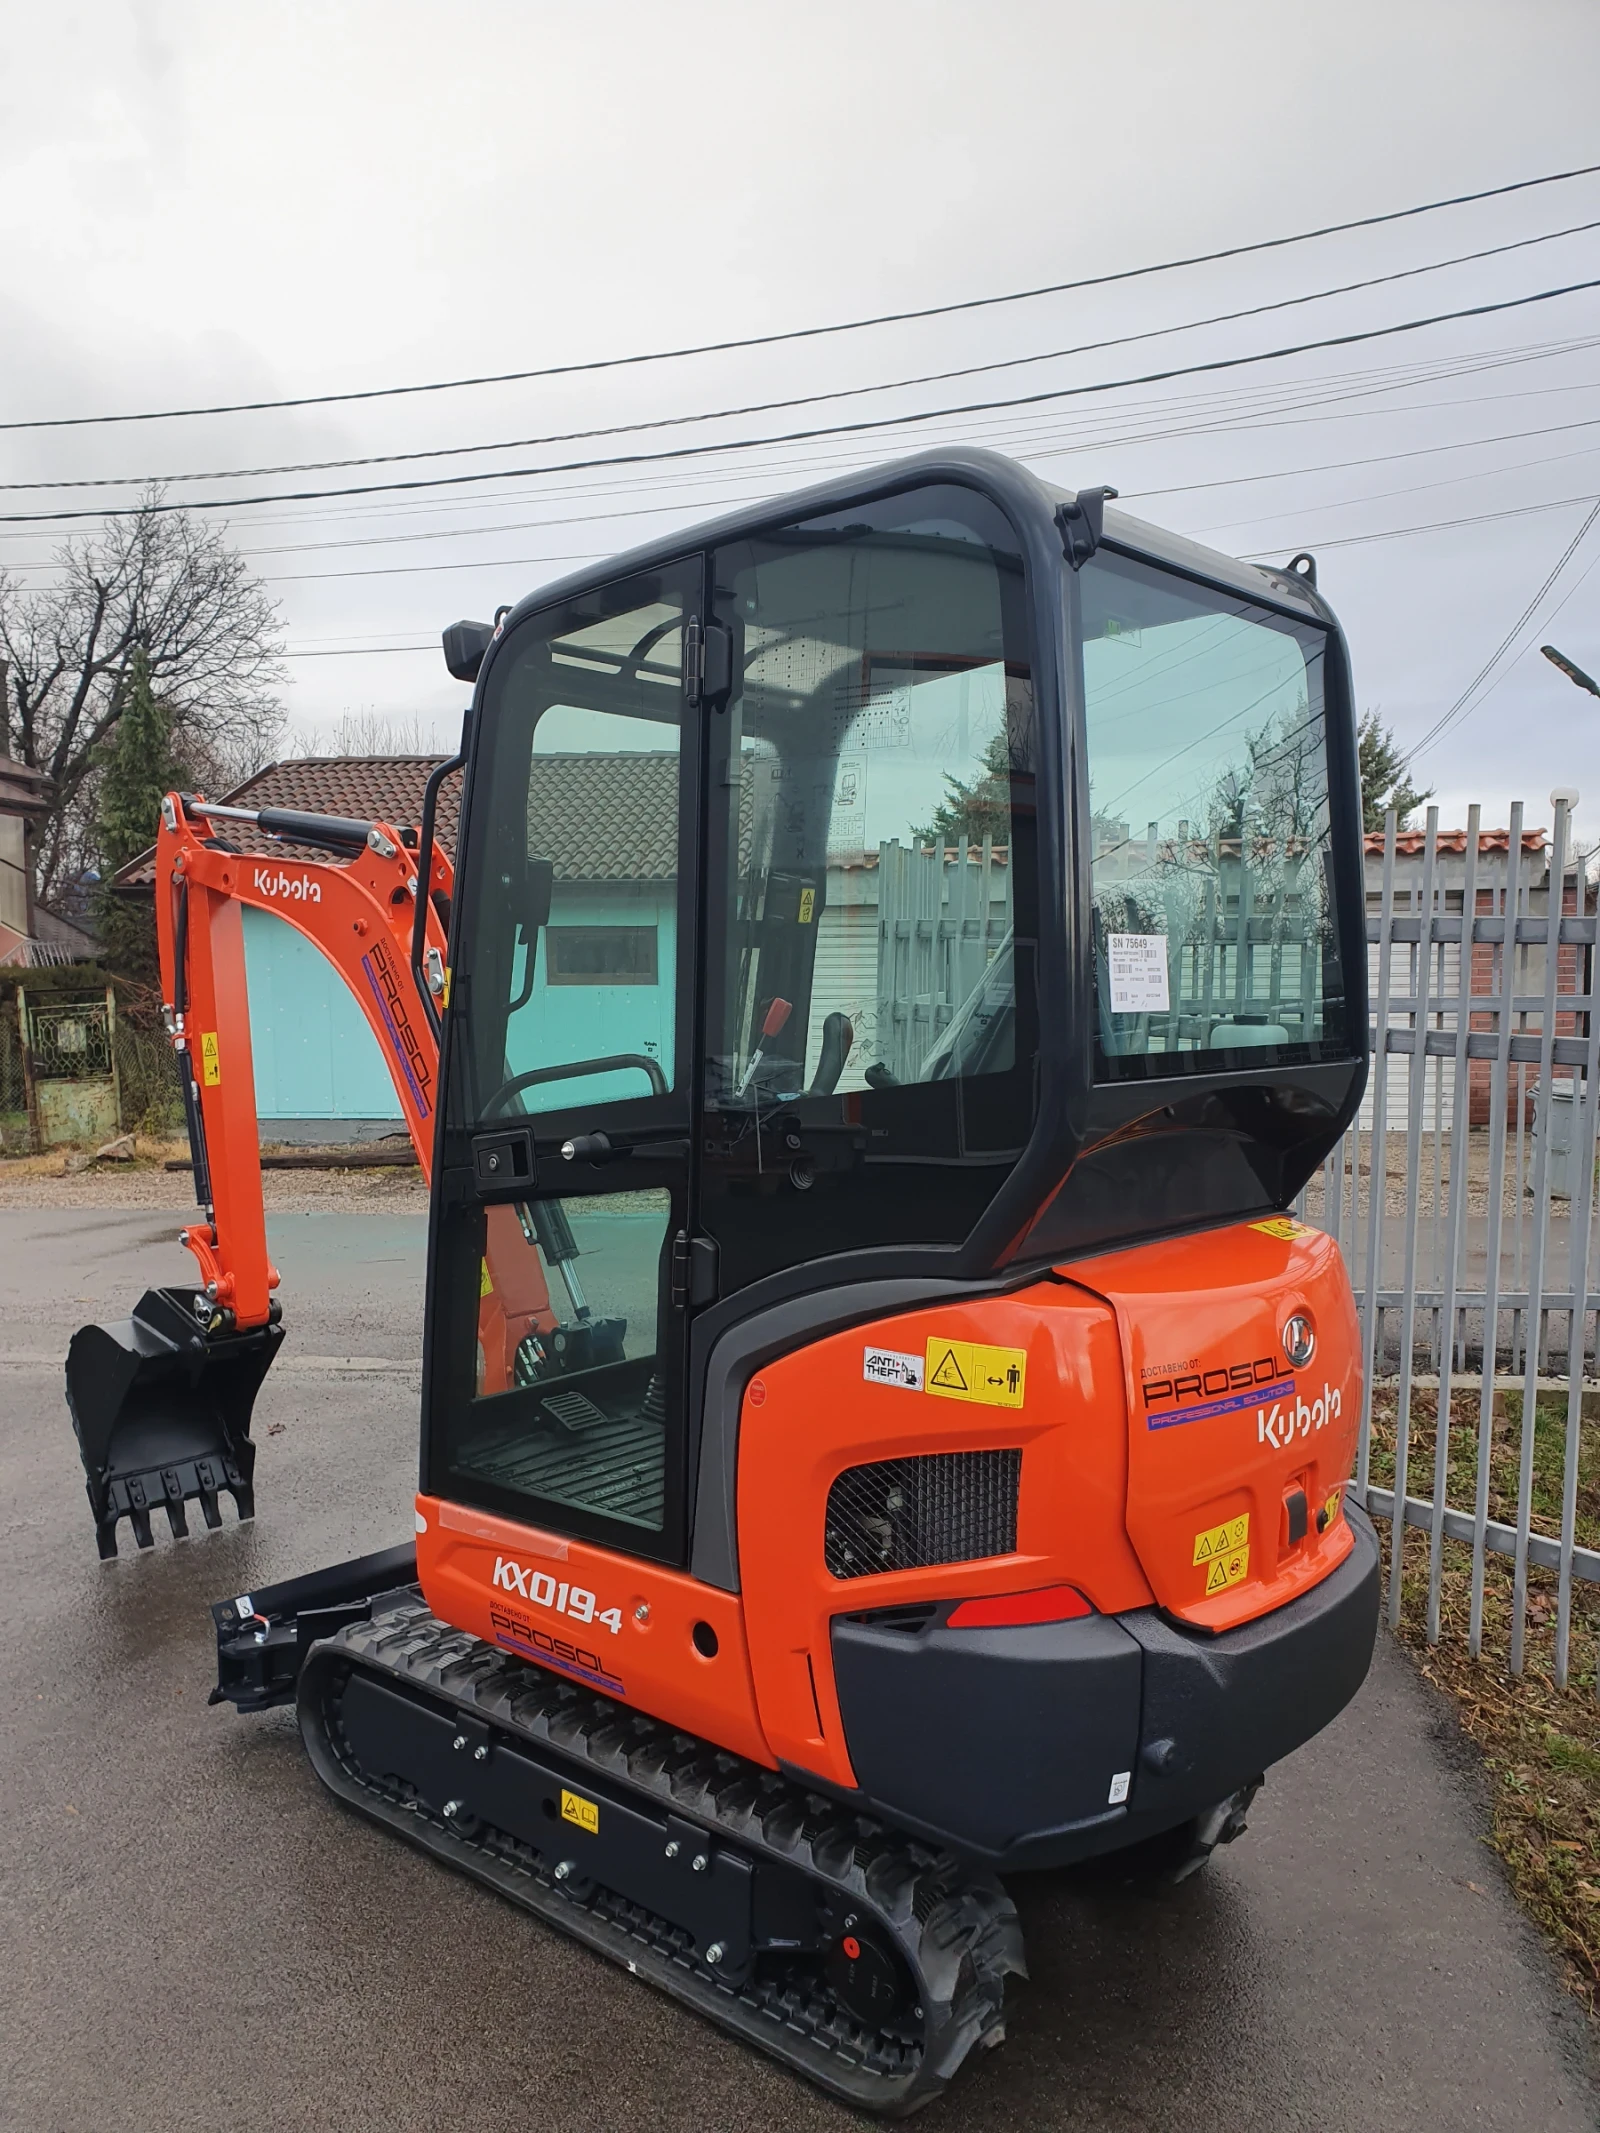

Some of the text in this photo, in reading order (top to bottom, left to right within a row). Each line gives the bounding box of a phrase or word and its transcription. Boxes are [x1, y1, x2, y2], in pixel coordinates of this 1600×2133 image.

[254, 868, 321, 902] Kubota
[1113, 937, 1148, 949] SN 75649
[369, 942, 432, 1112] PROSOL
[866, 1363, 900, 1379] THEFT
[867, 1355, 895, 1368] ANTI
[1140, 1361, 1188, 1379] ДОСТАВЕНО
[1142, 1356, 1294, 1408] PROSOL
[1151, 1384, 1294, 1426] PROFESSIONAL SOLUTIONS
[1257, 1382, 1341, 1449] Kubota
[492, 1556, 623, 1635] KX019-4
[490, 1612, 623, 1682] PROSOL
